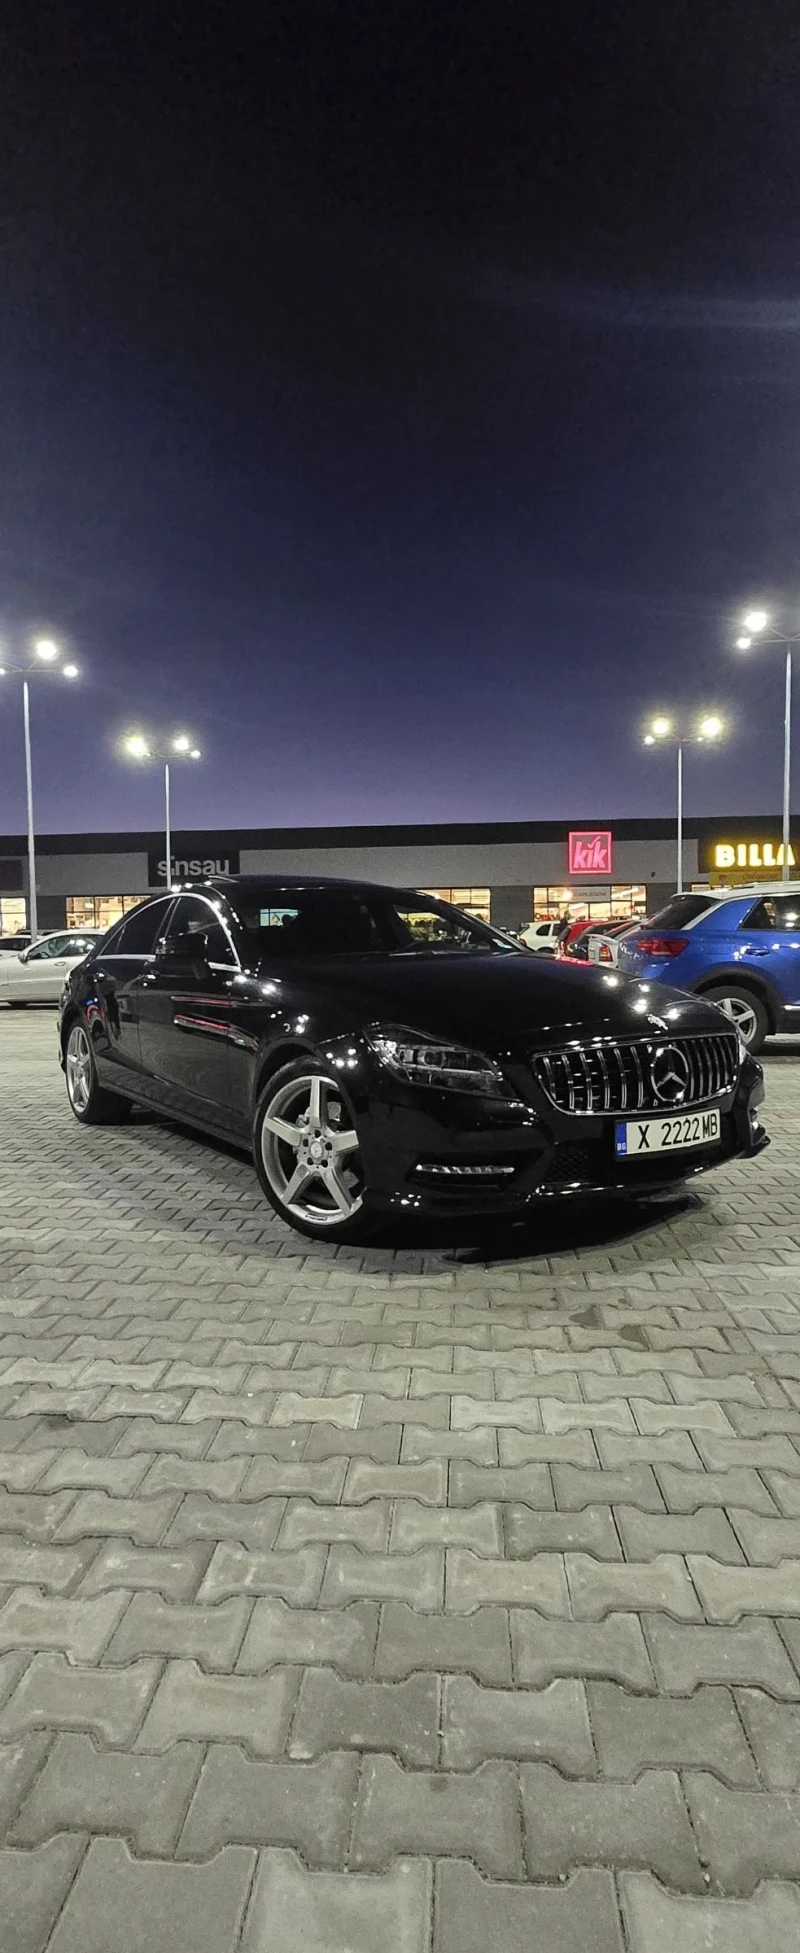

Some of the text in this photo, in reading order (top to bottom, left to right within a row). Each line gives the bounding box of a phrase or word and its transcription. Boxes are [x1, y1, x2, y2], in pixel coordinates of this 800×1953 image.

[715, 843, 796, 867] BILLA
[616, 1142, 627, 1151] BG
[638, 1124, 650, 1150] X
